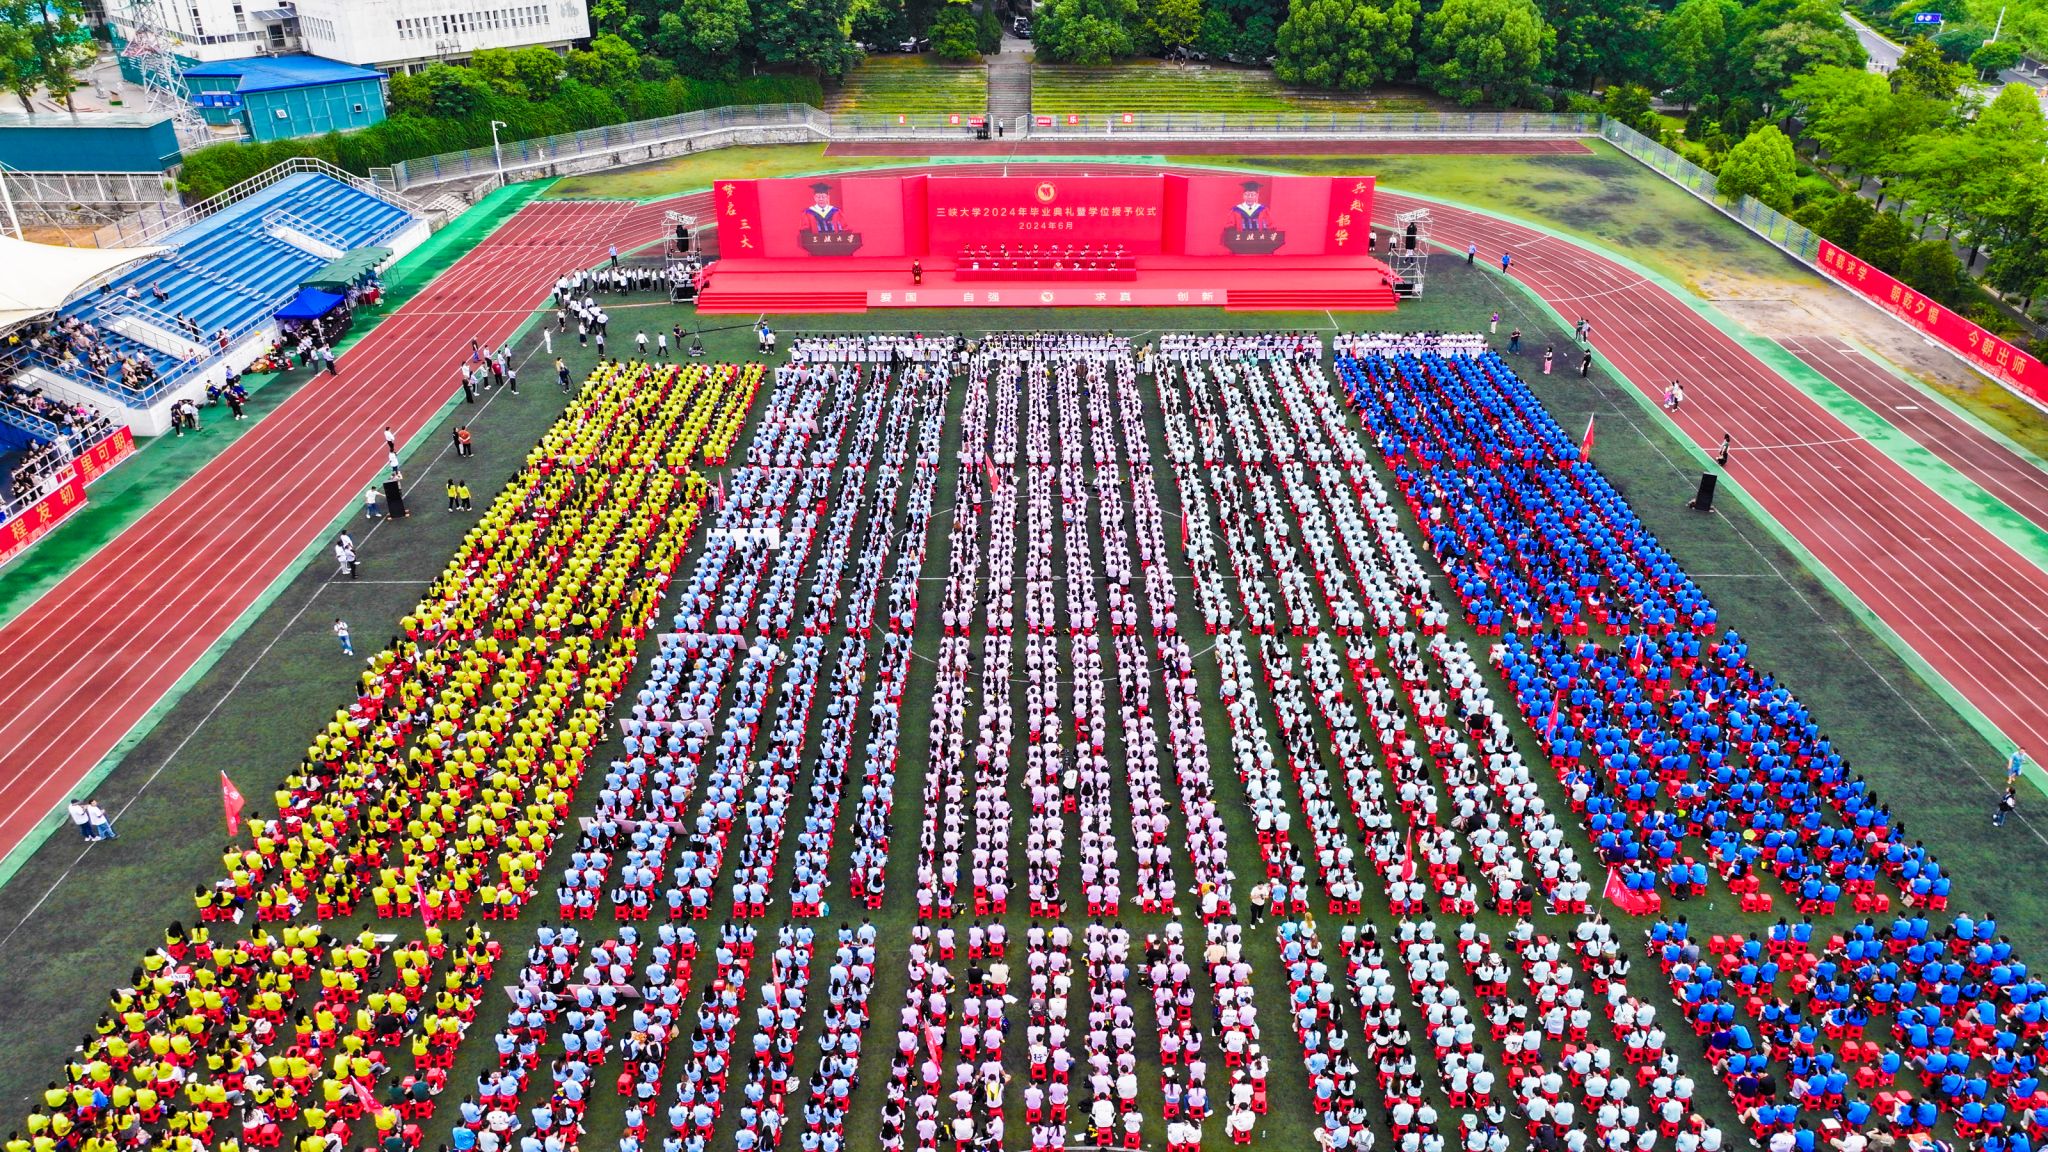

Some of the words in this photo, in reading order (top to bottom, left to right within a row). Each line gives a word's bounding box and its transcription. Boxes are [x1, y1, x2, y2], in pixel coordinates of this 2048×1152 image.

[936, 207, 1157, 217] 三峡大学2024年毕业典礼暨学位授予仪式
[1018, 222, 1073, 230] 2024年6月
[880, 292, 917, 303] 爱国
[963, 292, 1000, 303] 自强
[1095, 292, 1131, 302] 求真
[1177, 292, 1213, 302] 创新
[1825, 248, 1868, 281] 数载求学
[1890, 285, 1940, 325] 朝乾夕惕
[1968, 330, 2027, 375] 今朝出师
